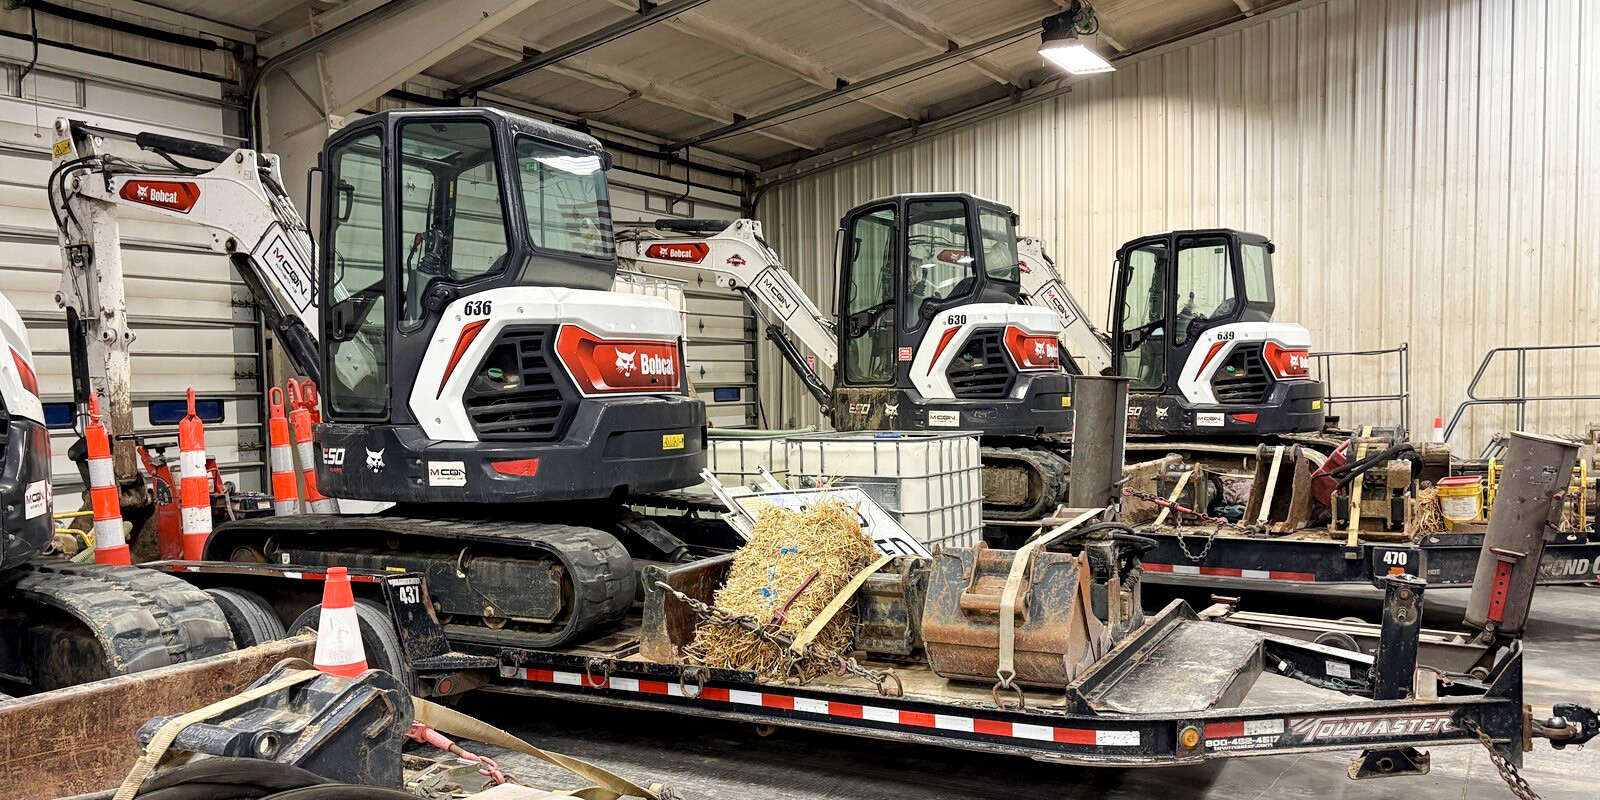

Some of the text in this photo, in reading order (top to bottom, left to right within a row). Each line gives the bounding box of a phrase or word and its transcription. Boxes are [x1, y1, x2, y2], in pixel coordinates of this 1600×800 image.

[150, 188, 178, 204] Bobcat
[670, 249, 692, 258] Bobcat
[464, 300, 492, 316] 636
[948, 315, 967, 325] 630
[1217, 331, 1235, 340] 639
[640, 353, 673, 376] Bobcat
[1128, 406, 1142, 416] 50
[322, 448, 346, 465] E50
[1383, 551, 1407, 566] 470
[400, 586, 420, 604] 437
[1289, 710, 1461, 742] TOWMASTER
